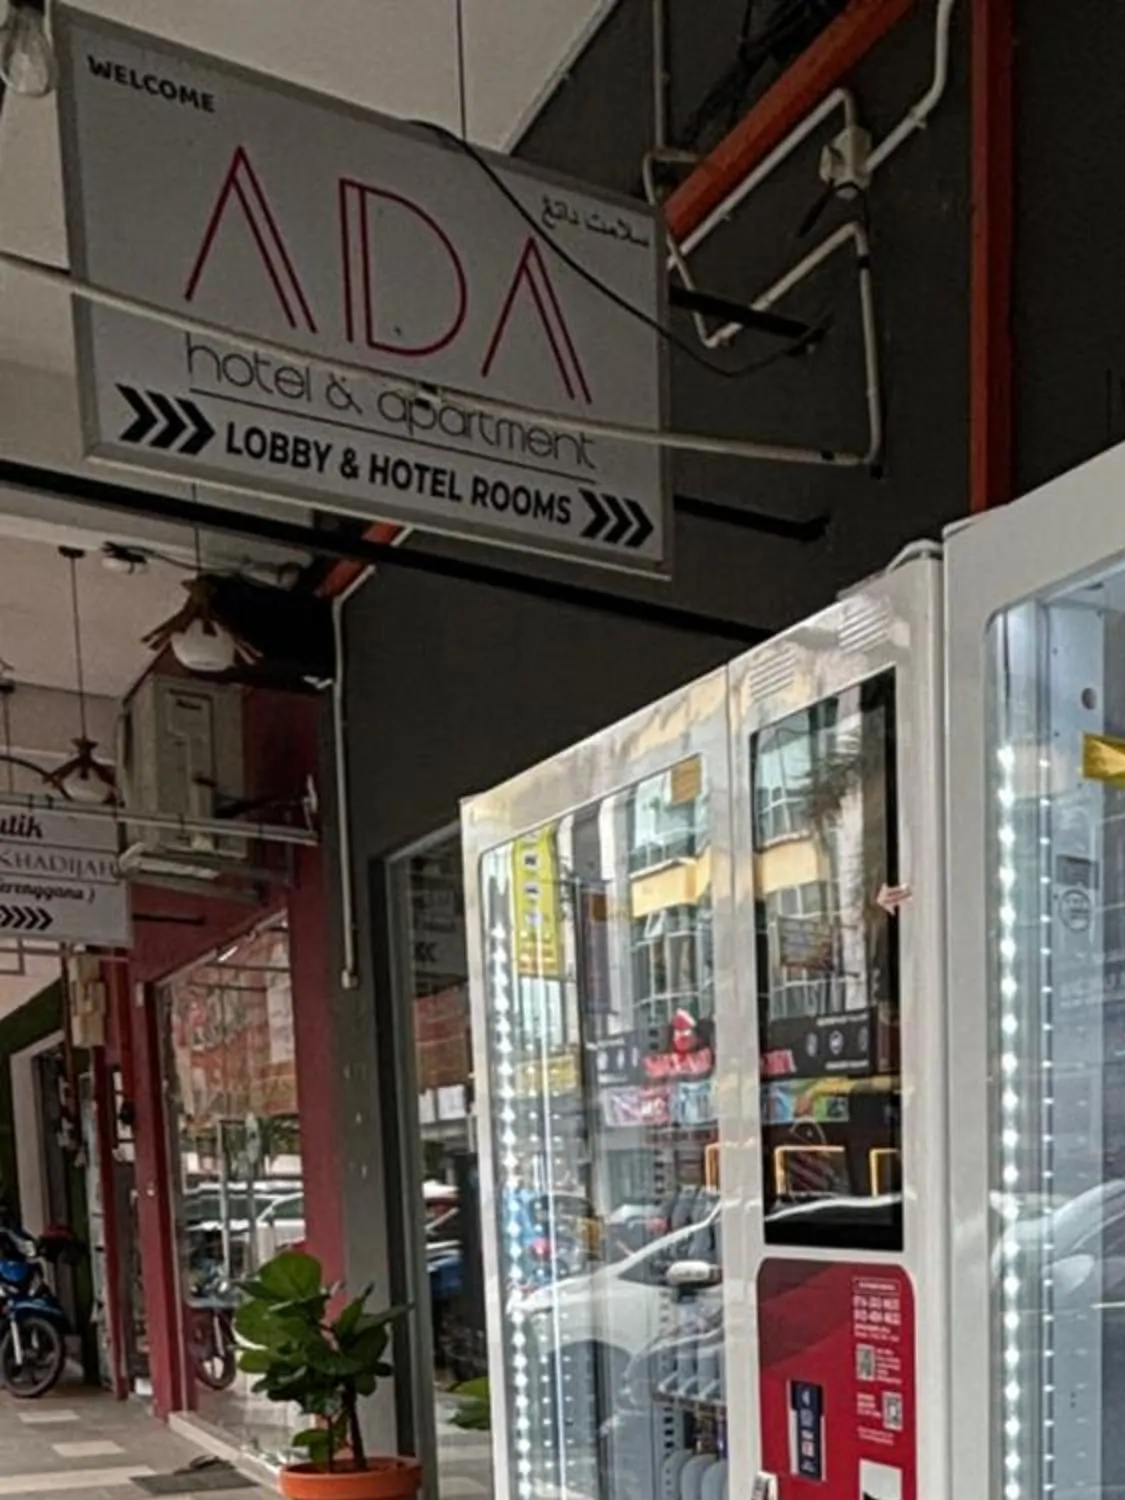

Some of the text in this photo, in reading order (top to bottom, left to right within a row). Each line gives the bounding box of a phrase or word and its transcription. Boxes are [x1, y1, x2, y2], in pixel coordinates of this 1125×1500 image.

[87, 54, 215, 113] WELCOME
[185, 145, 593, 405] ADA
[185, 331, 312, 403] hotel
[377, 389, 598, 470] apartment
[226, 421, 573, 526] LOBBY & HOTEL ROOMS
